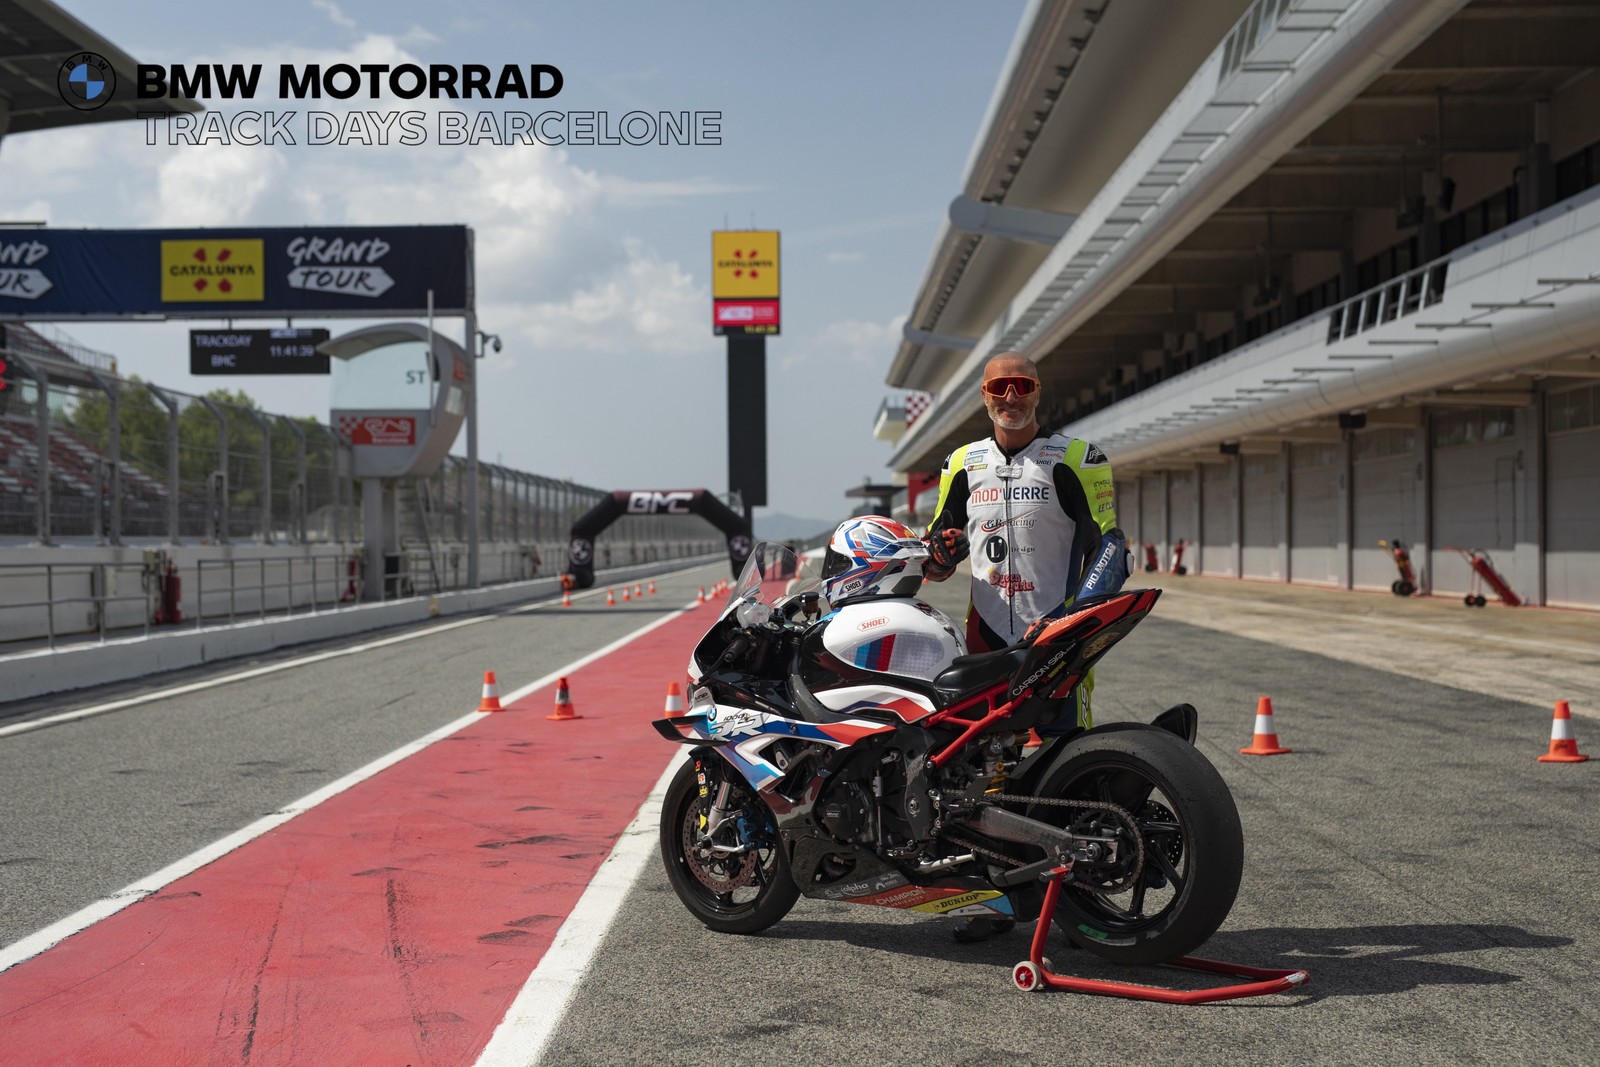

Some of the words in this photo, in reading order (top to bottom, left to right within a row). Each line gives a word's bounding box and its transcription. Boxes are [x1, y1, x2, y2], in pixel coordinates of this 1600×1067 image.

[0, 240, 49, 266] ND
[286, 236, 391, 266] GRAND
[170, 264, 255, 277] CATALUNYA
[300, 270, 377, 292] TOUR
[210, 354, 238, 367] BMC
[626, 491, 694, 513] BMC
[845, 580, 862, 592] SHOEI
[861, 618, 886, 630] SHOEI
[841, 882, 870, 895] alpha
[876, 886, 926, 905] CHAMPION
[940, 893, 981, 909] DUNLOP
